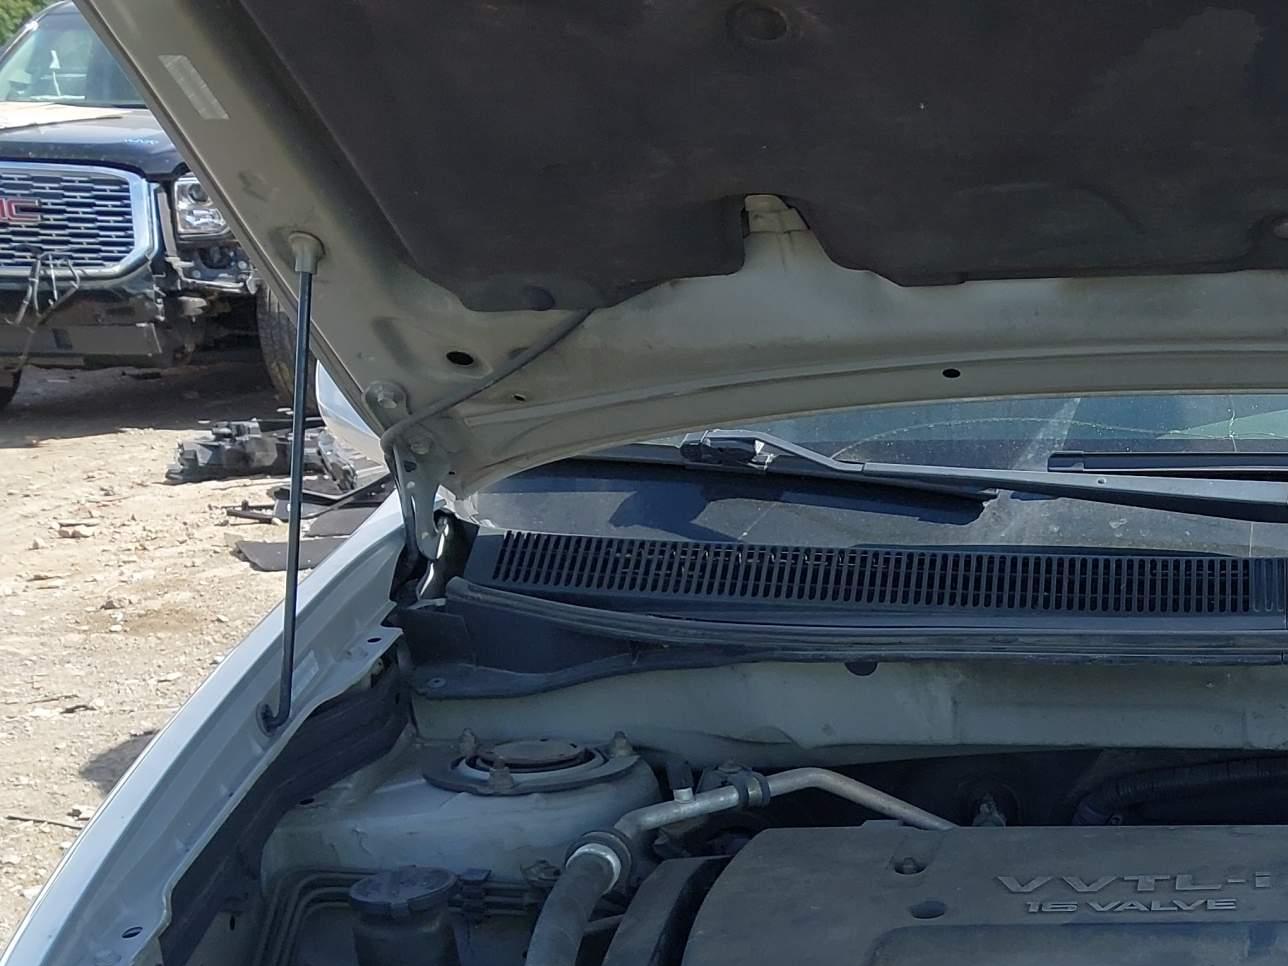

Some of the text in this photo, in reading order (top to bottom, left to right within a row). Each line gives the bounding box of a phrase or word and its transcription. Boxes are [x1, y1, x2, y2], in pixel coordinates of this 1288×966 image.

[996, 871, 1271, 893] VVTL-i
[1024, 898, 1238, 913] 16 VALVE
